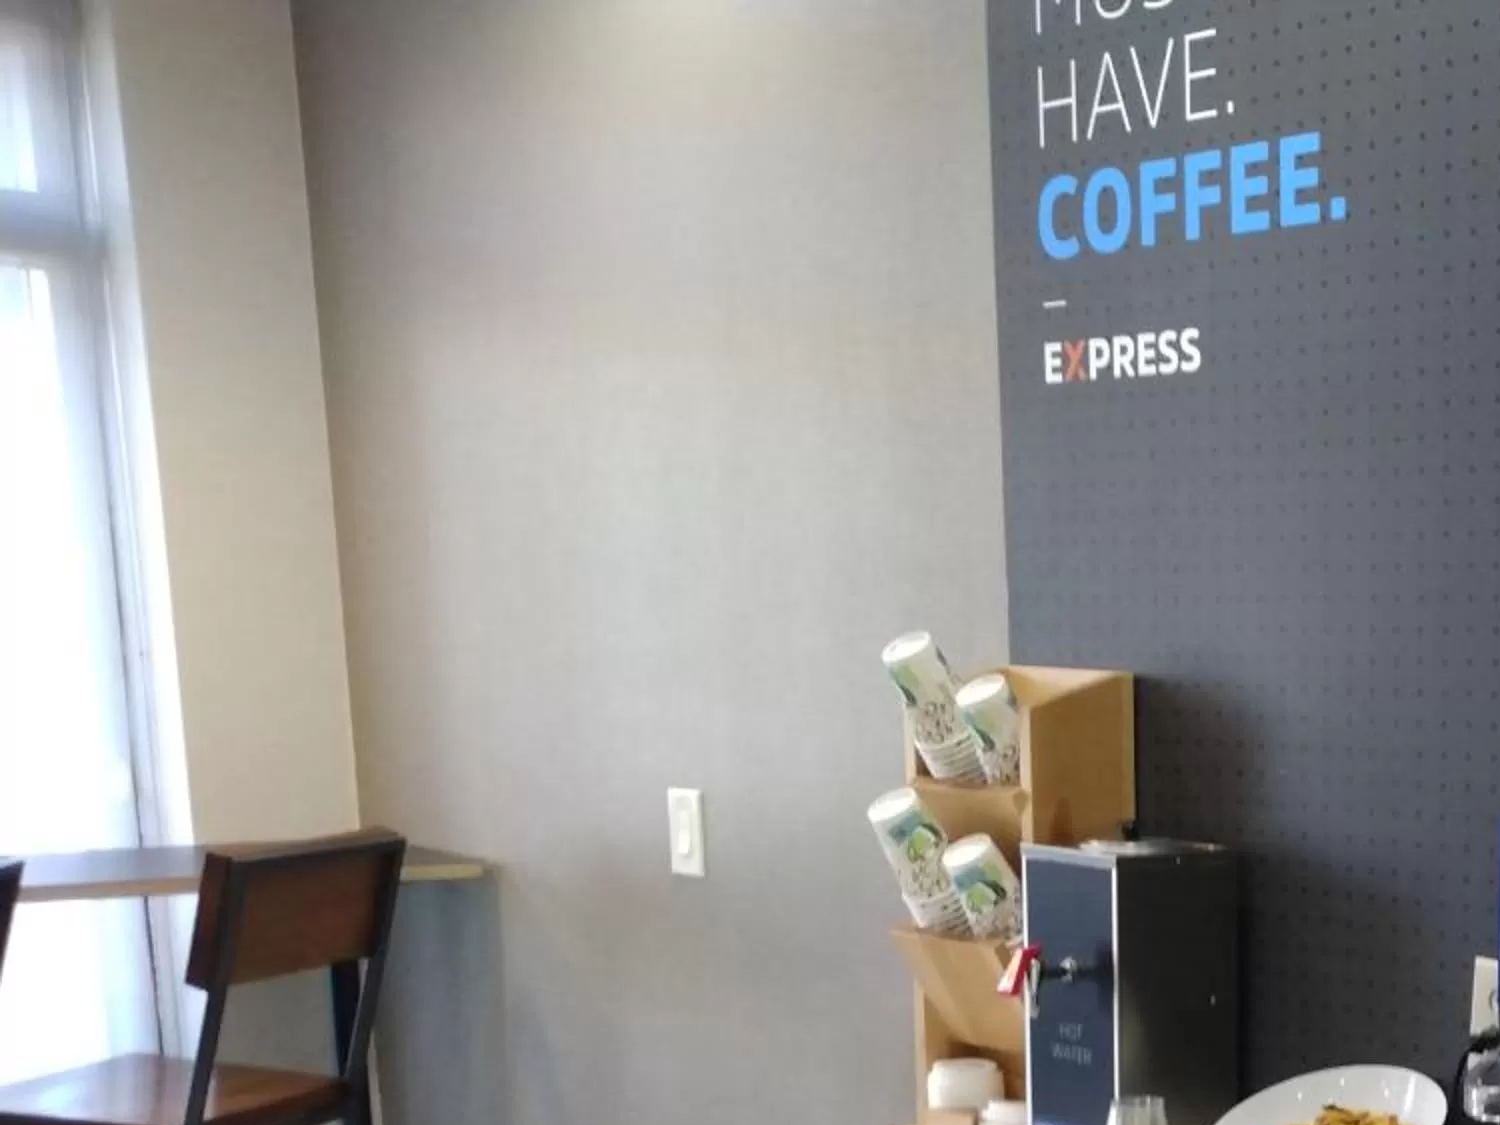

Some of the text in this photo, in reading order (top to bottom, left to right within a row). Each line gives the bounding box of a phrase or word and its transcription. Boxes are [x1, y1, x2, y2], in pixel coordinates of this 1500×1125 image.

[1037, 28, 1235, 148] HAVE.
[1037, 132, 1346, 260] COFFEE.
[1043, 327, 1202, 384] EXPRESS
